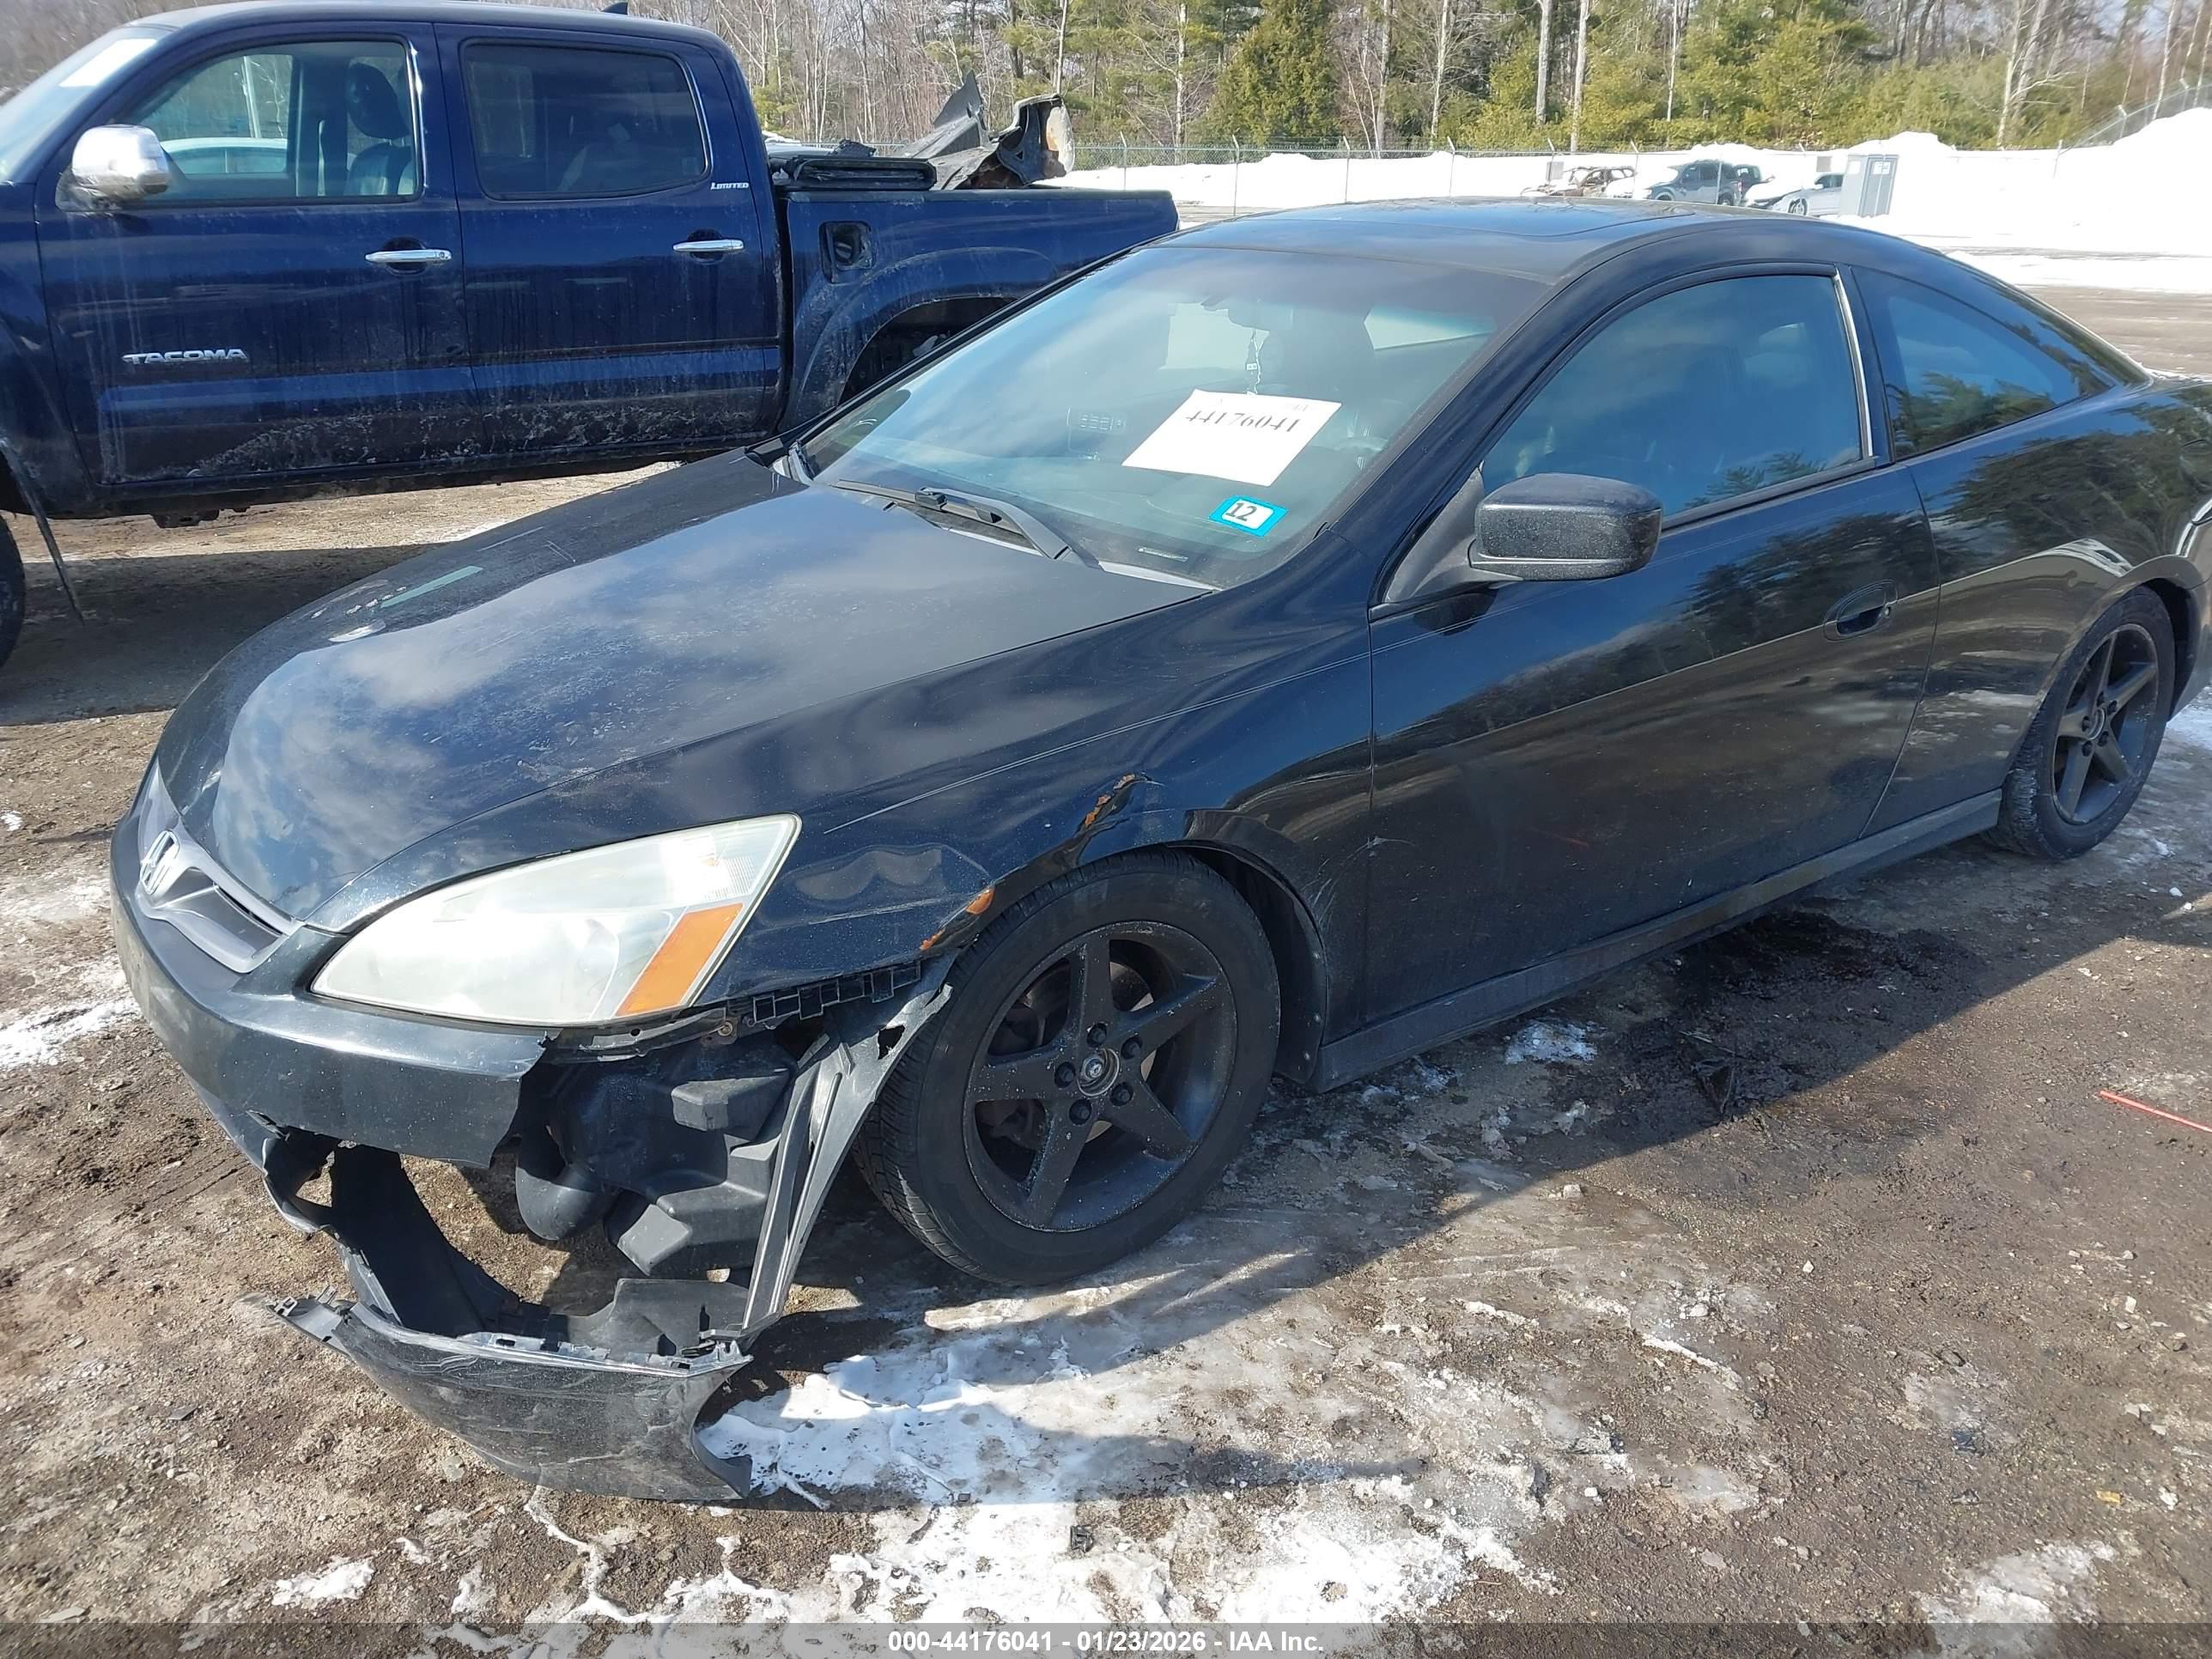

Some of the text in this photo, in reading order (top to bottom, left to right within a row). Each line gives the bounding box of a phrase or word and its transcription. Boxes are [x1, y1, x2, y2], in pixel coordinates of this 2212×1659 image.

[121, 348, 249, 365] TACOMA
[1185, 410, 1301, 432] 44176041
[1225, 502, 1257, 521] 12
